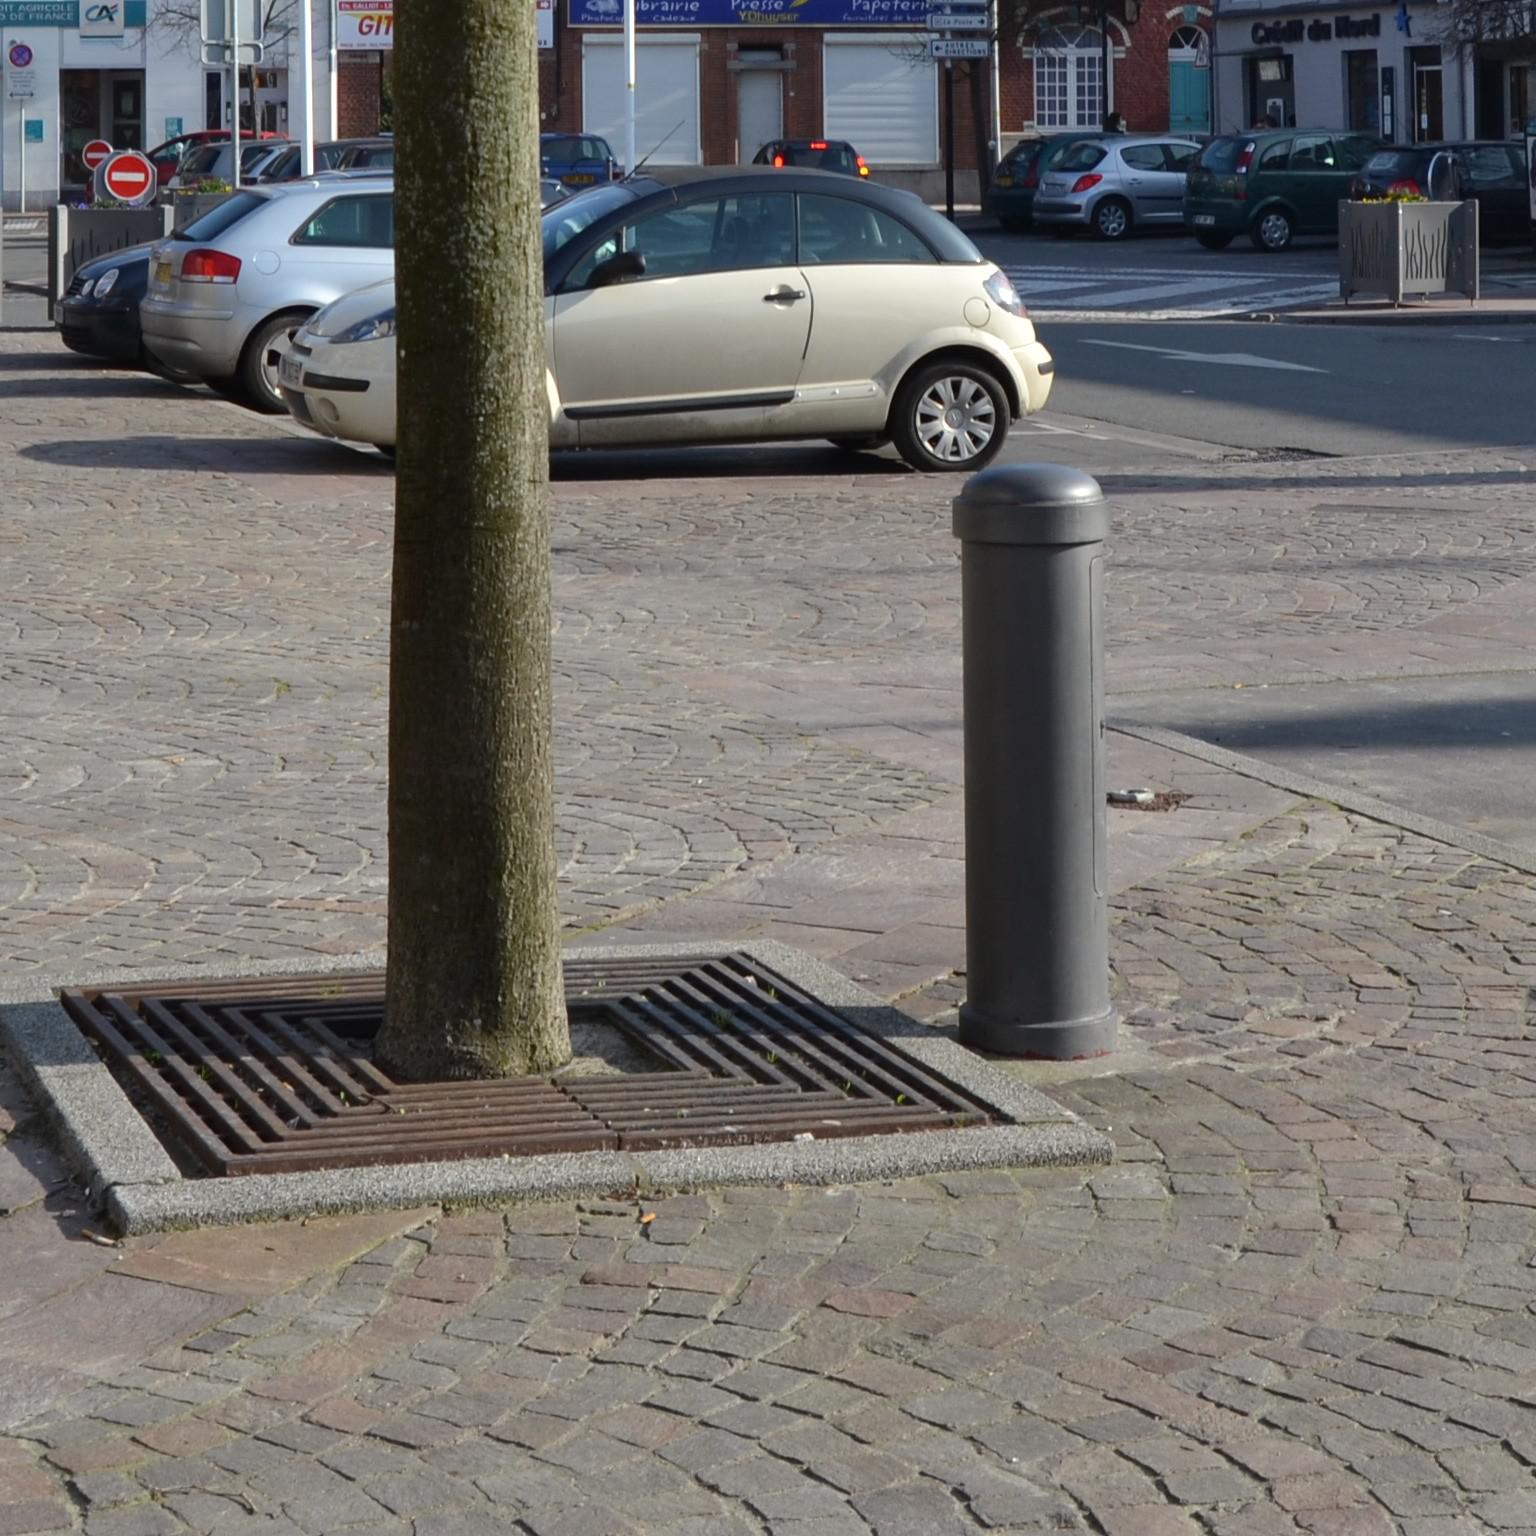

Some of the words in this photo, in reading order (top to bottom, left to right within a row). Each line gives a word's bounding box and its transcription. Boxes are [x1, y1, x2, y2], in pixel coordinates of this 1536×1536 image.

[17, 4, 74, 13] AGRICOLE
[9, 13, 25, 21] DE
[28, 13, 74, 21] FRANCE
[357, 15, 394, 36] GIT
